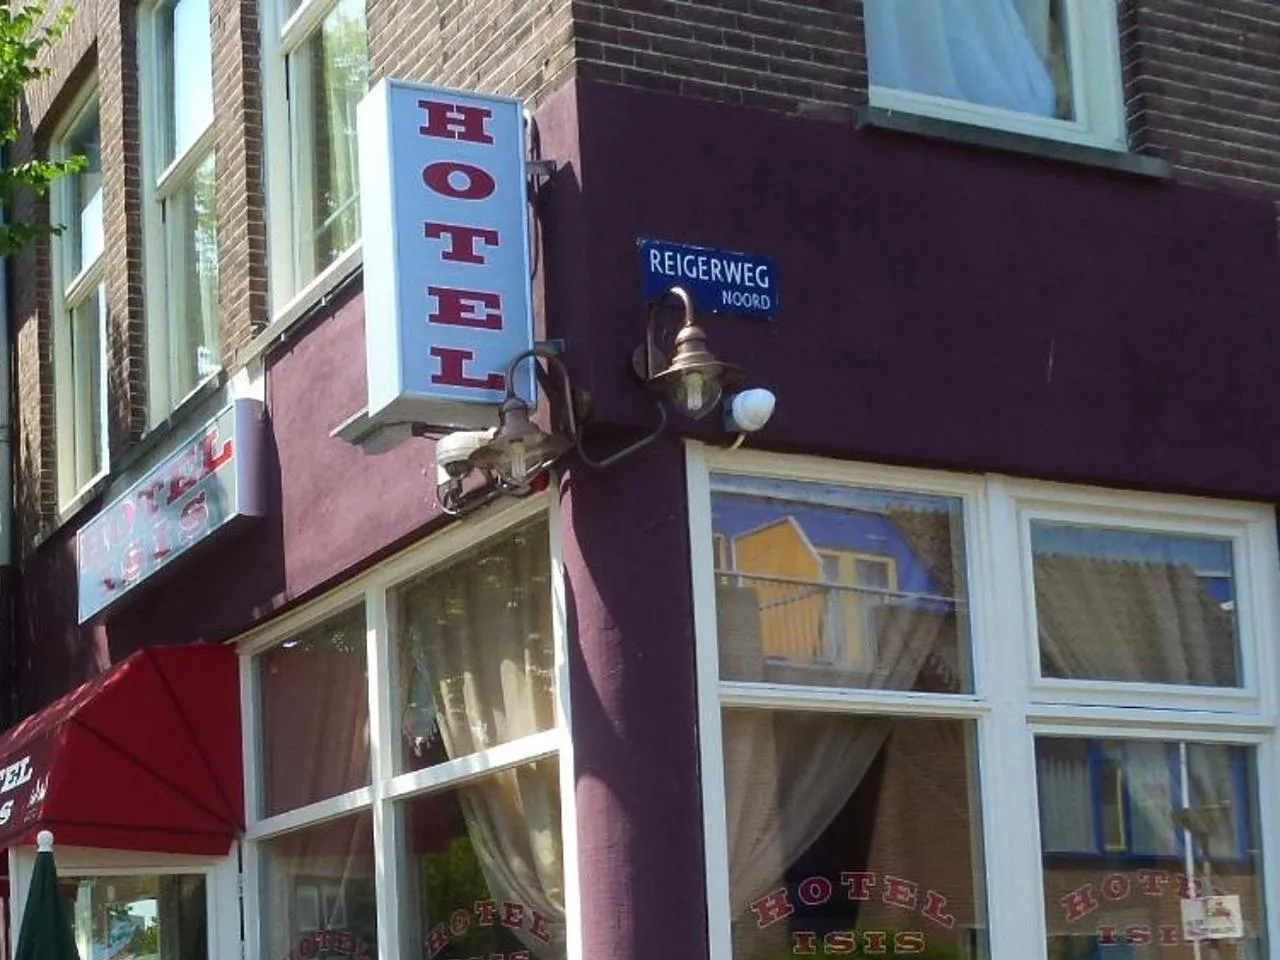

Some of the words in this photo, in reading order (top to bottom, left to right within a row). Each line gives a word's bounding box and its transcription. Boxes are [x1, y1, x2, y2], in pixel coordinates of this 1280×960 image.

[417, 99, 507, 393] HOTEL
[649, 248, 770, 289] REIGERWEG
[721, 289, 772, 311] NOORD
[750, 871, 957, 929] HOTEL
[425, 900, 552, 960] HOTEL
[793, 931, 926, 955] ISIS
